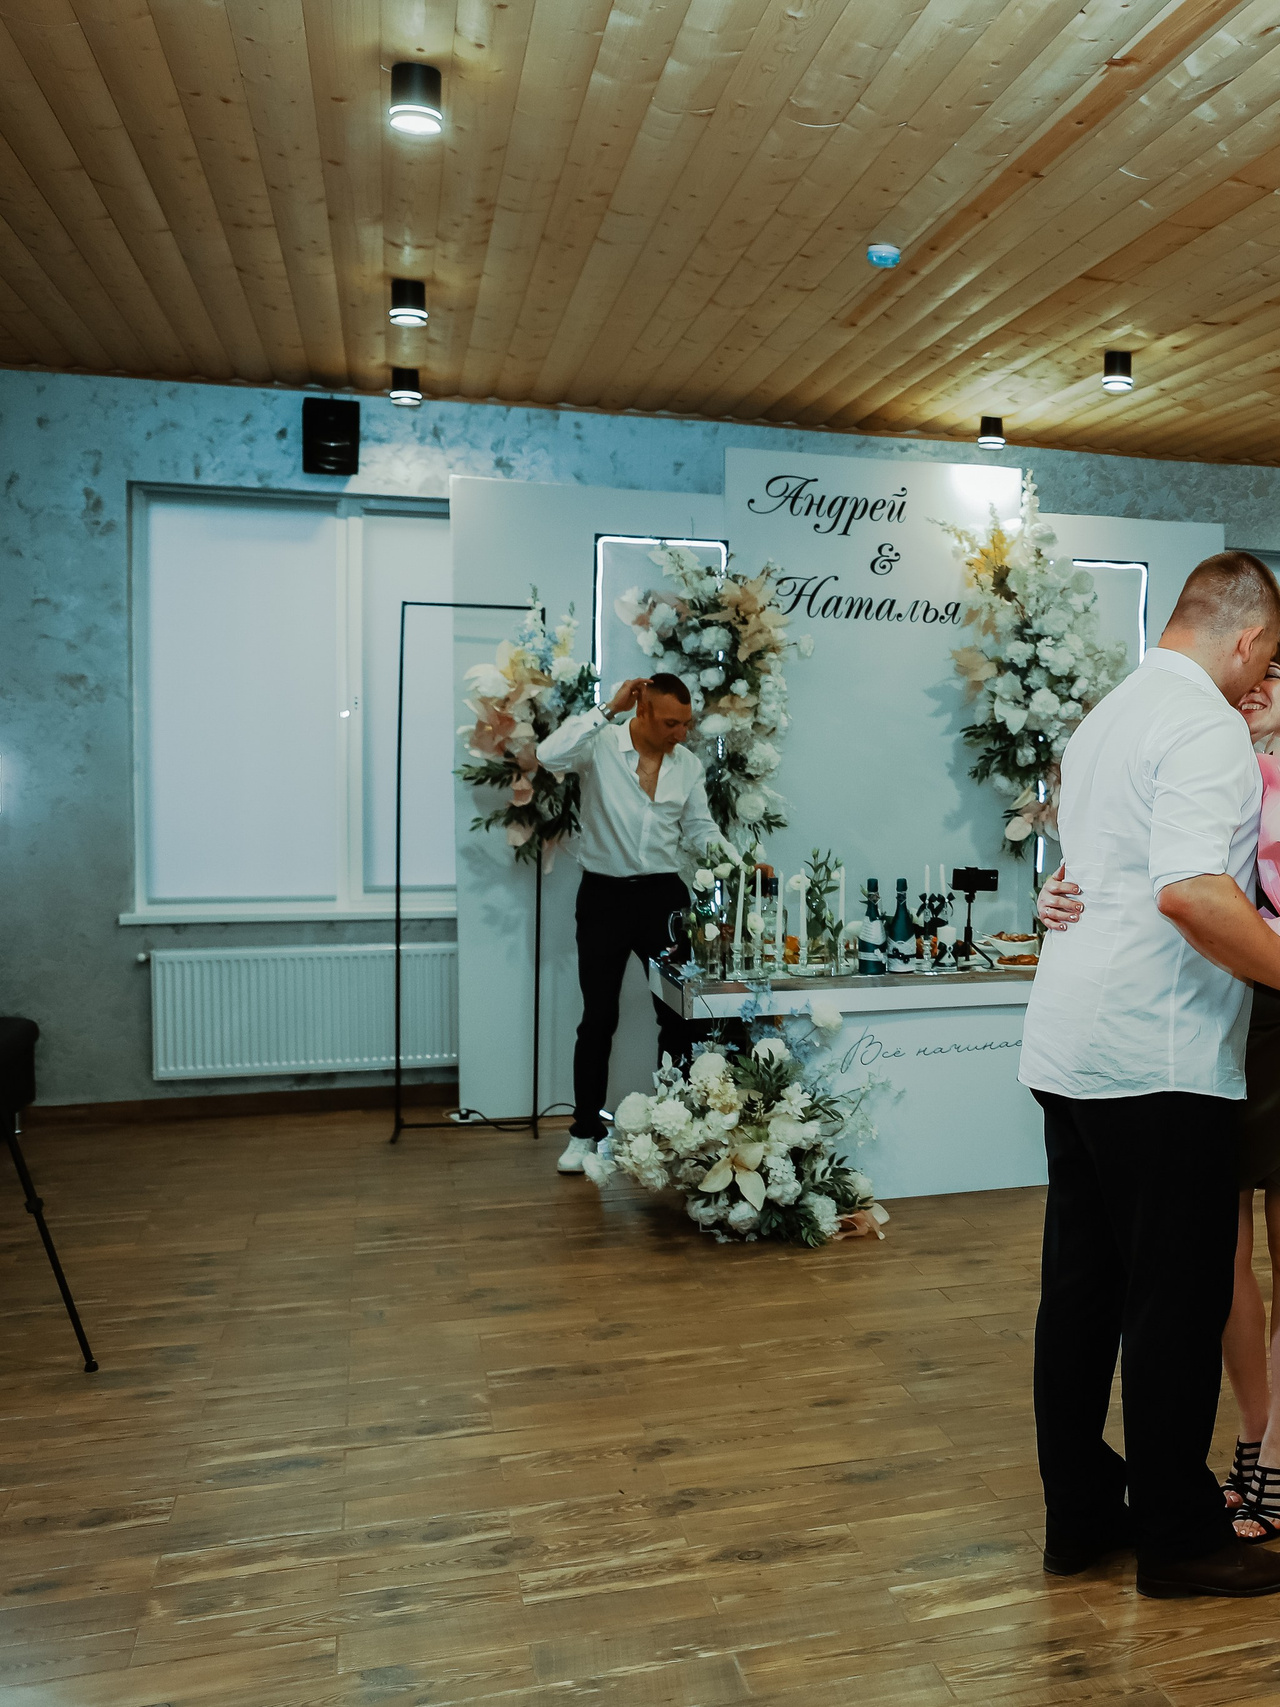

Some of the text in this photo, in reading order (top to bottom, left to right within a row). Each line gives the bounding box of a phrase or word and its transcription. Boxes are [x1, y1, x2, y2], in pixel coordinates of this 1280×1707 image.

[748, 475, 908, 536] Андрей
[870, 543, 901, 575] &
[775, 575, 962, 625] Наталья
[840, 1026, 905, 1074] Всё
